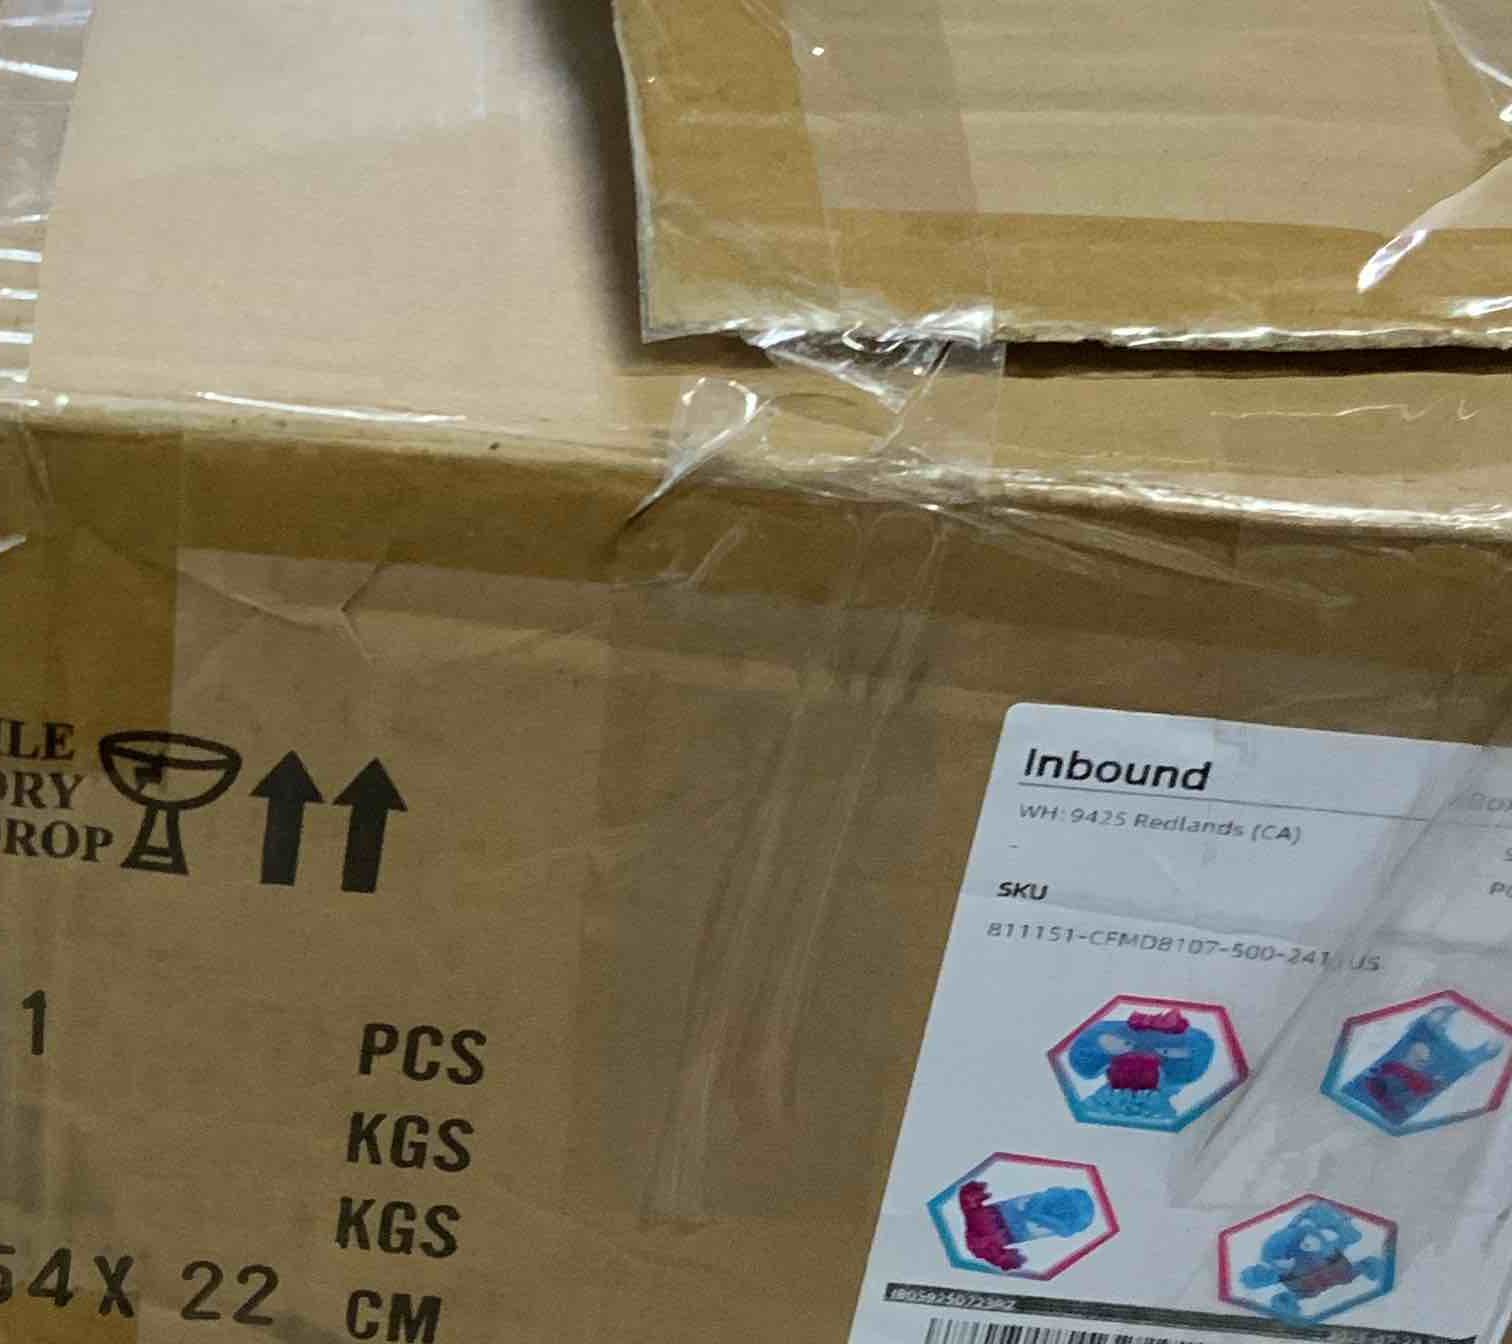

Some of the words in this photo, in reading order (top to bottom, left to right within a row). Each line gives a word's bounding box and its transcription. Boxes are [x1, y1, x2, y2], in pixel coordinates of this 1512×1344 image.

[1023, 747, 1213, 791] Inbound
[1070, 807, 1128, 827] 9425
[1133, 813, 1245, 838] Redlands
[1250, 822, 1304, 847] (CA)
[997, 881, 1049, 902] SKU
[21, 989, 49, 1056] 1
[358, 1023, 487, 1086] PCS
[345, 1111, 475, 1173] KGS
[335, 1196, 461, 1259] KGS
[180, 1259, 280, 1327] 22
